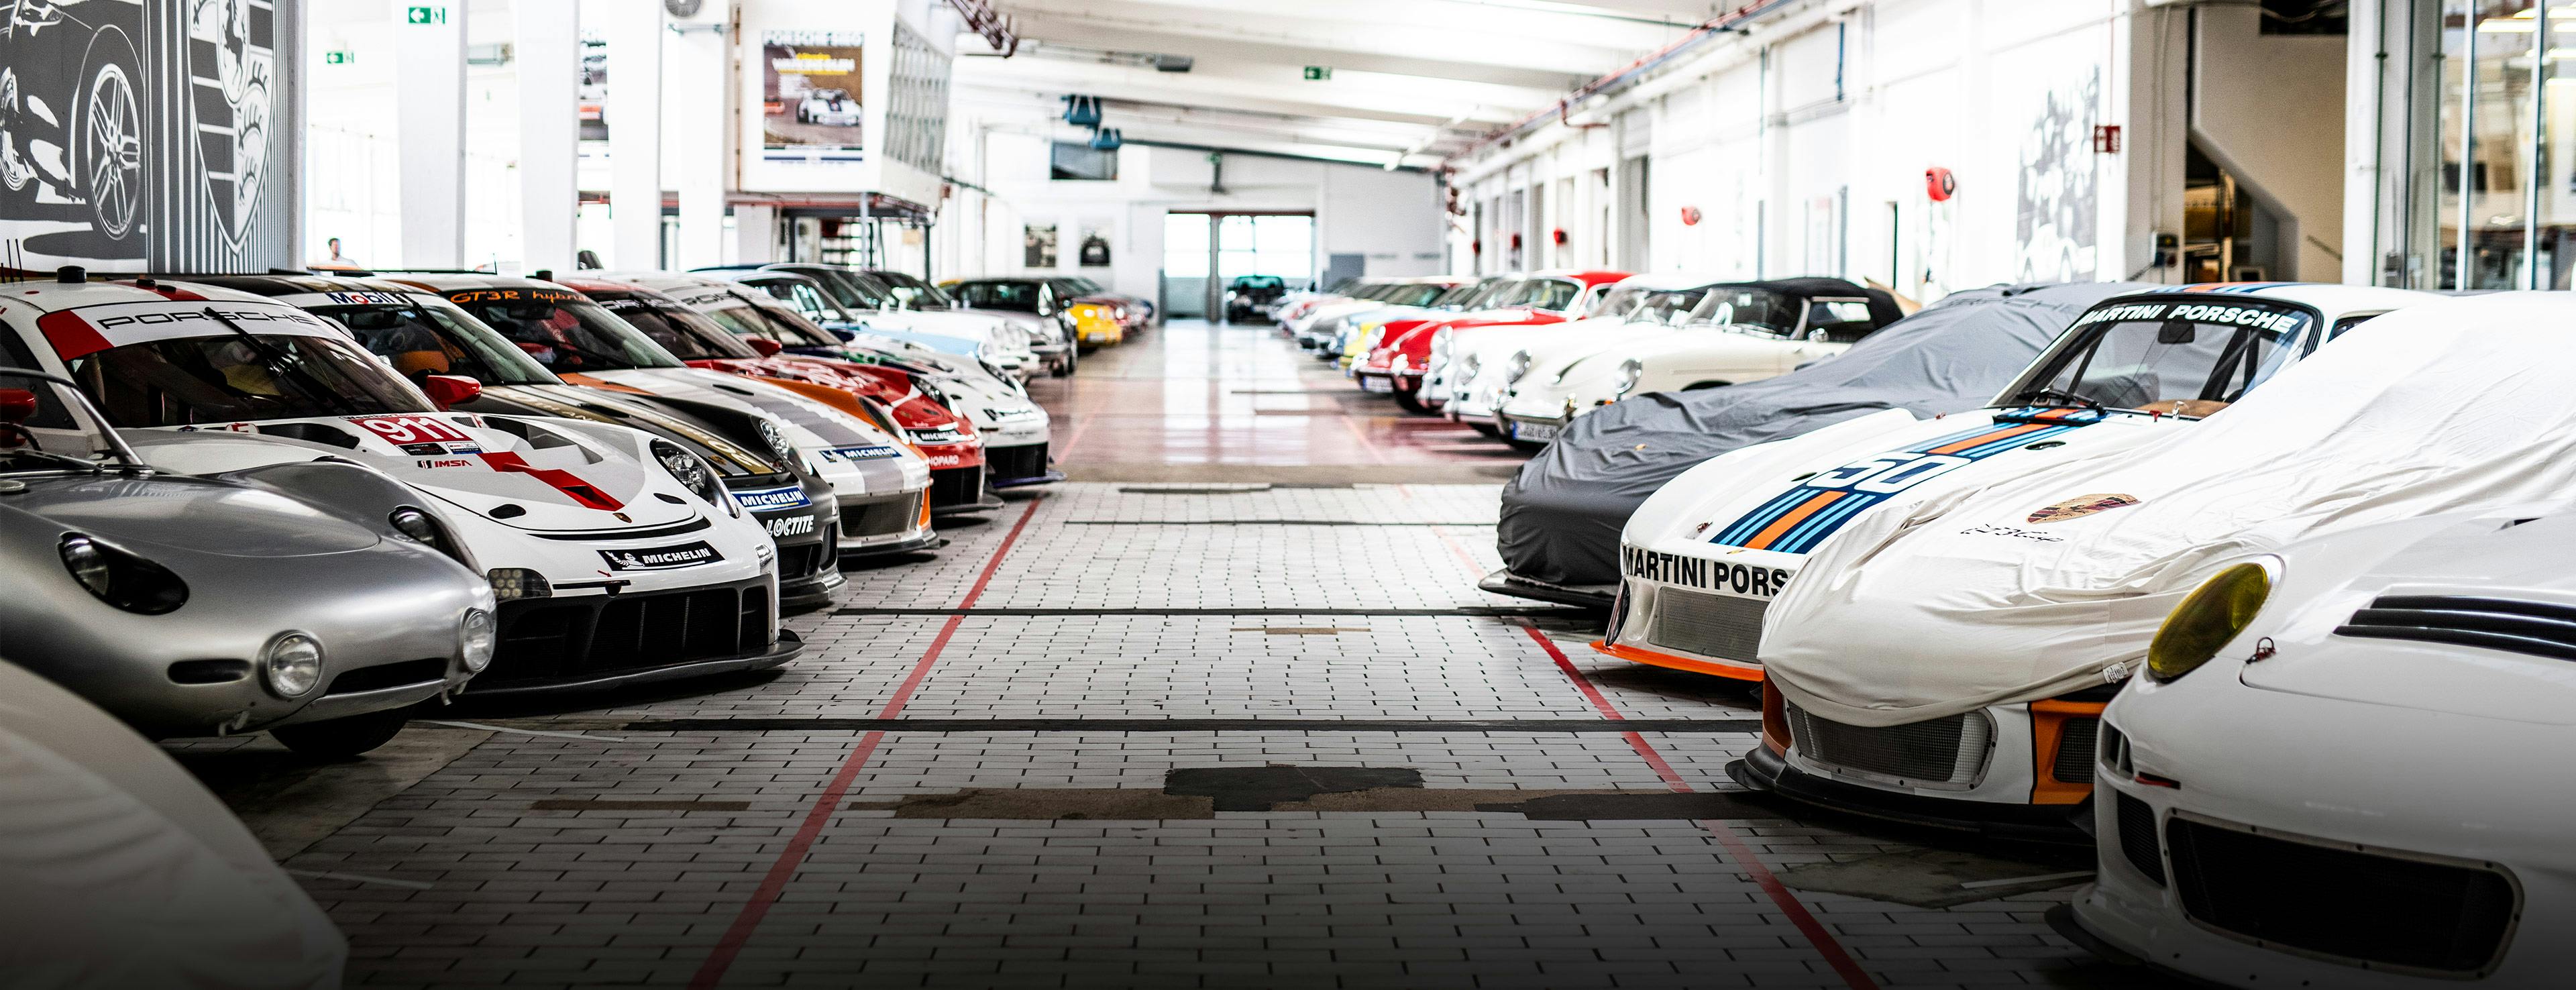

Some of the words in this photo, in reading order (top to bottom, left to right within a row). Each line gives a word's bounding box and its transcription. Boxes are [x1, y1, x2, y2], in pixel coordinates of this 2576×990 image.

[325, 291, 394, 303] Mobil
[450, 290, 520, 303] GT3R
[96, 311, 321, 329] PORSCHE
[2078, 305, 2167, 327] MARTINI
[2167, 305, 2299, 334] PORSCHE
[364, 417, 464, 441] 911
[844, 448, 896, 457] MICHELIN
[929, 455, 959, 468] HOPARD
[1807, 451, 1972, 494] 50
[741, 490, 804, 506] MICHELIN
[765, 514, 814, 537] LOCTITE
[642, 548, 711, 564] MICHELIN
[1623, 545, 1706, 589] MARTINI
[1714, 561, 1790, 598] PORS
